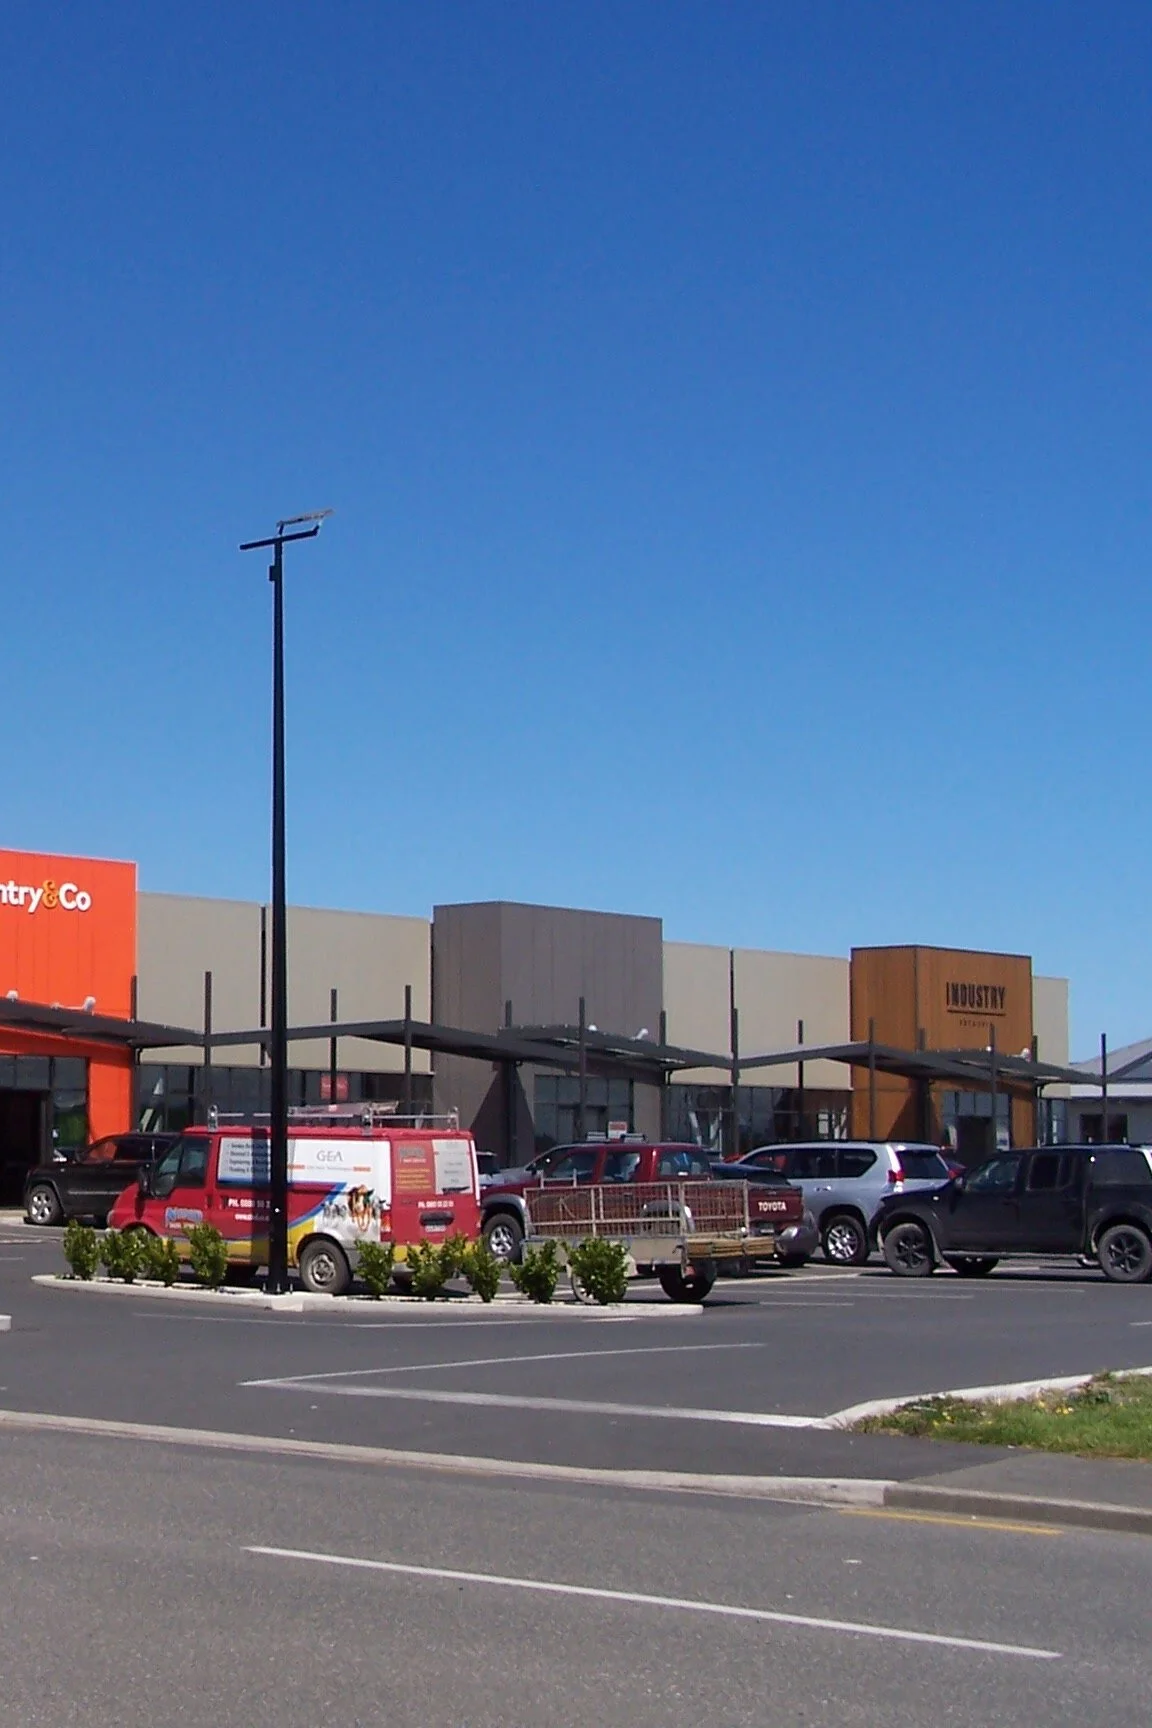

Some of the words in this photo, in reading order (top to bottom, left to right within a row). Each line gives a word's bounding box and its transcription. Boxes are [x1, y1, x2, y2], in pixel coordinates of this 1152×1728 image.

[946, 981, 1006, 1009] INDUSTRY
[316, 1150, 344, 1162] GEA
[758, 1201, 787, 1212] TOYOTA
